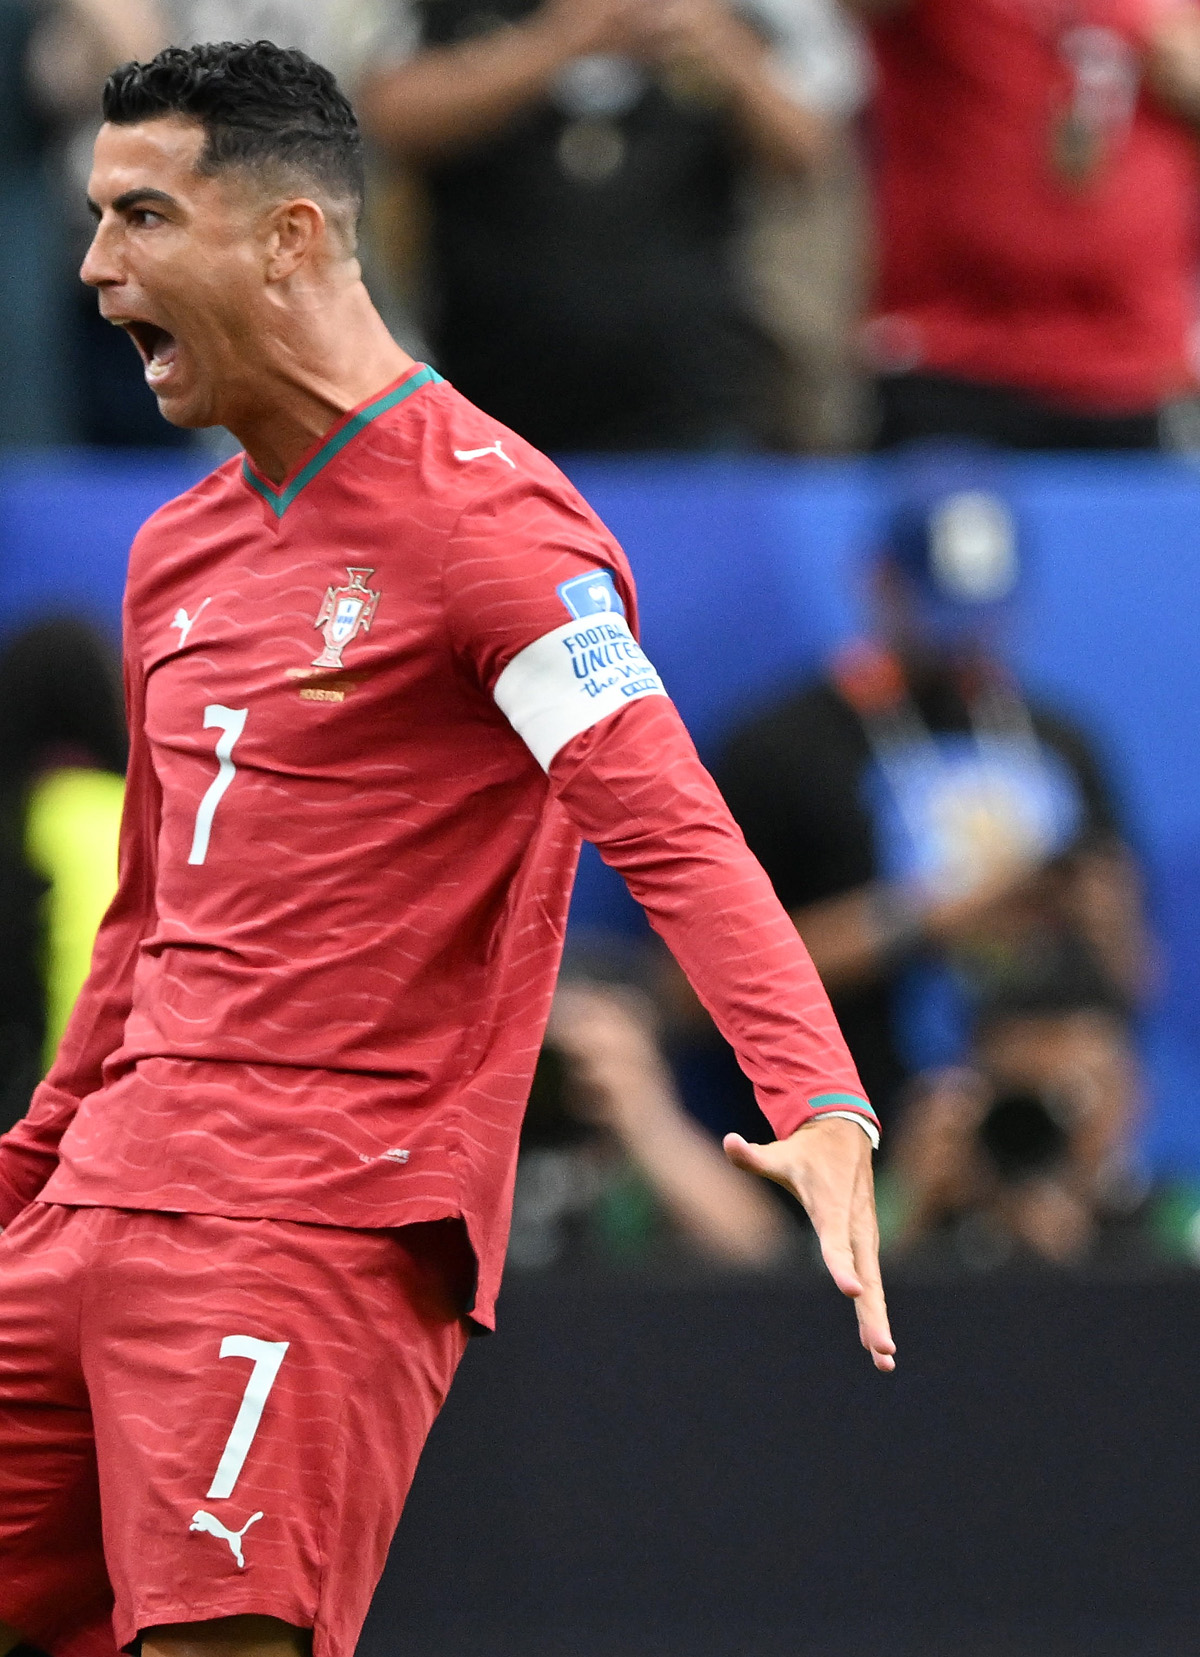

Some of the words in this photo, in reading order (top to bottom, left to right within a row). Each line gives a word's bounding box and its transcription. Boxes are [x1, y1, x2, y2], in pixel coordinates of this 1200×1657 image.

[562, 624, 632, 654] FOOTB
[571, 641, 648, 679] UNITE
[187, 703, 249, 866] 7
[206, 1334, 291, 1499] 7
